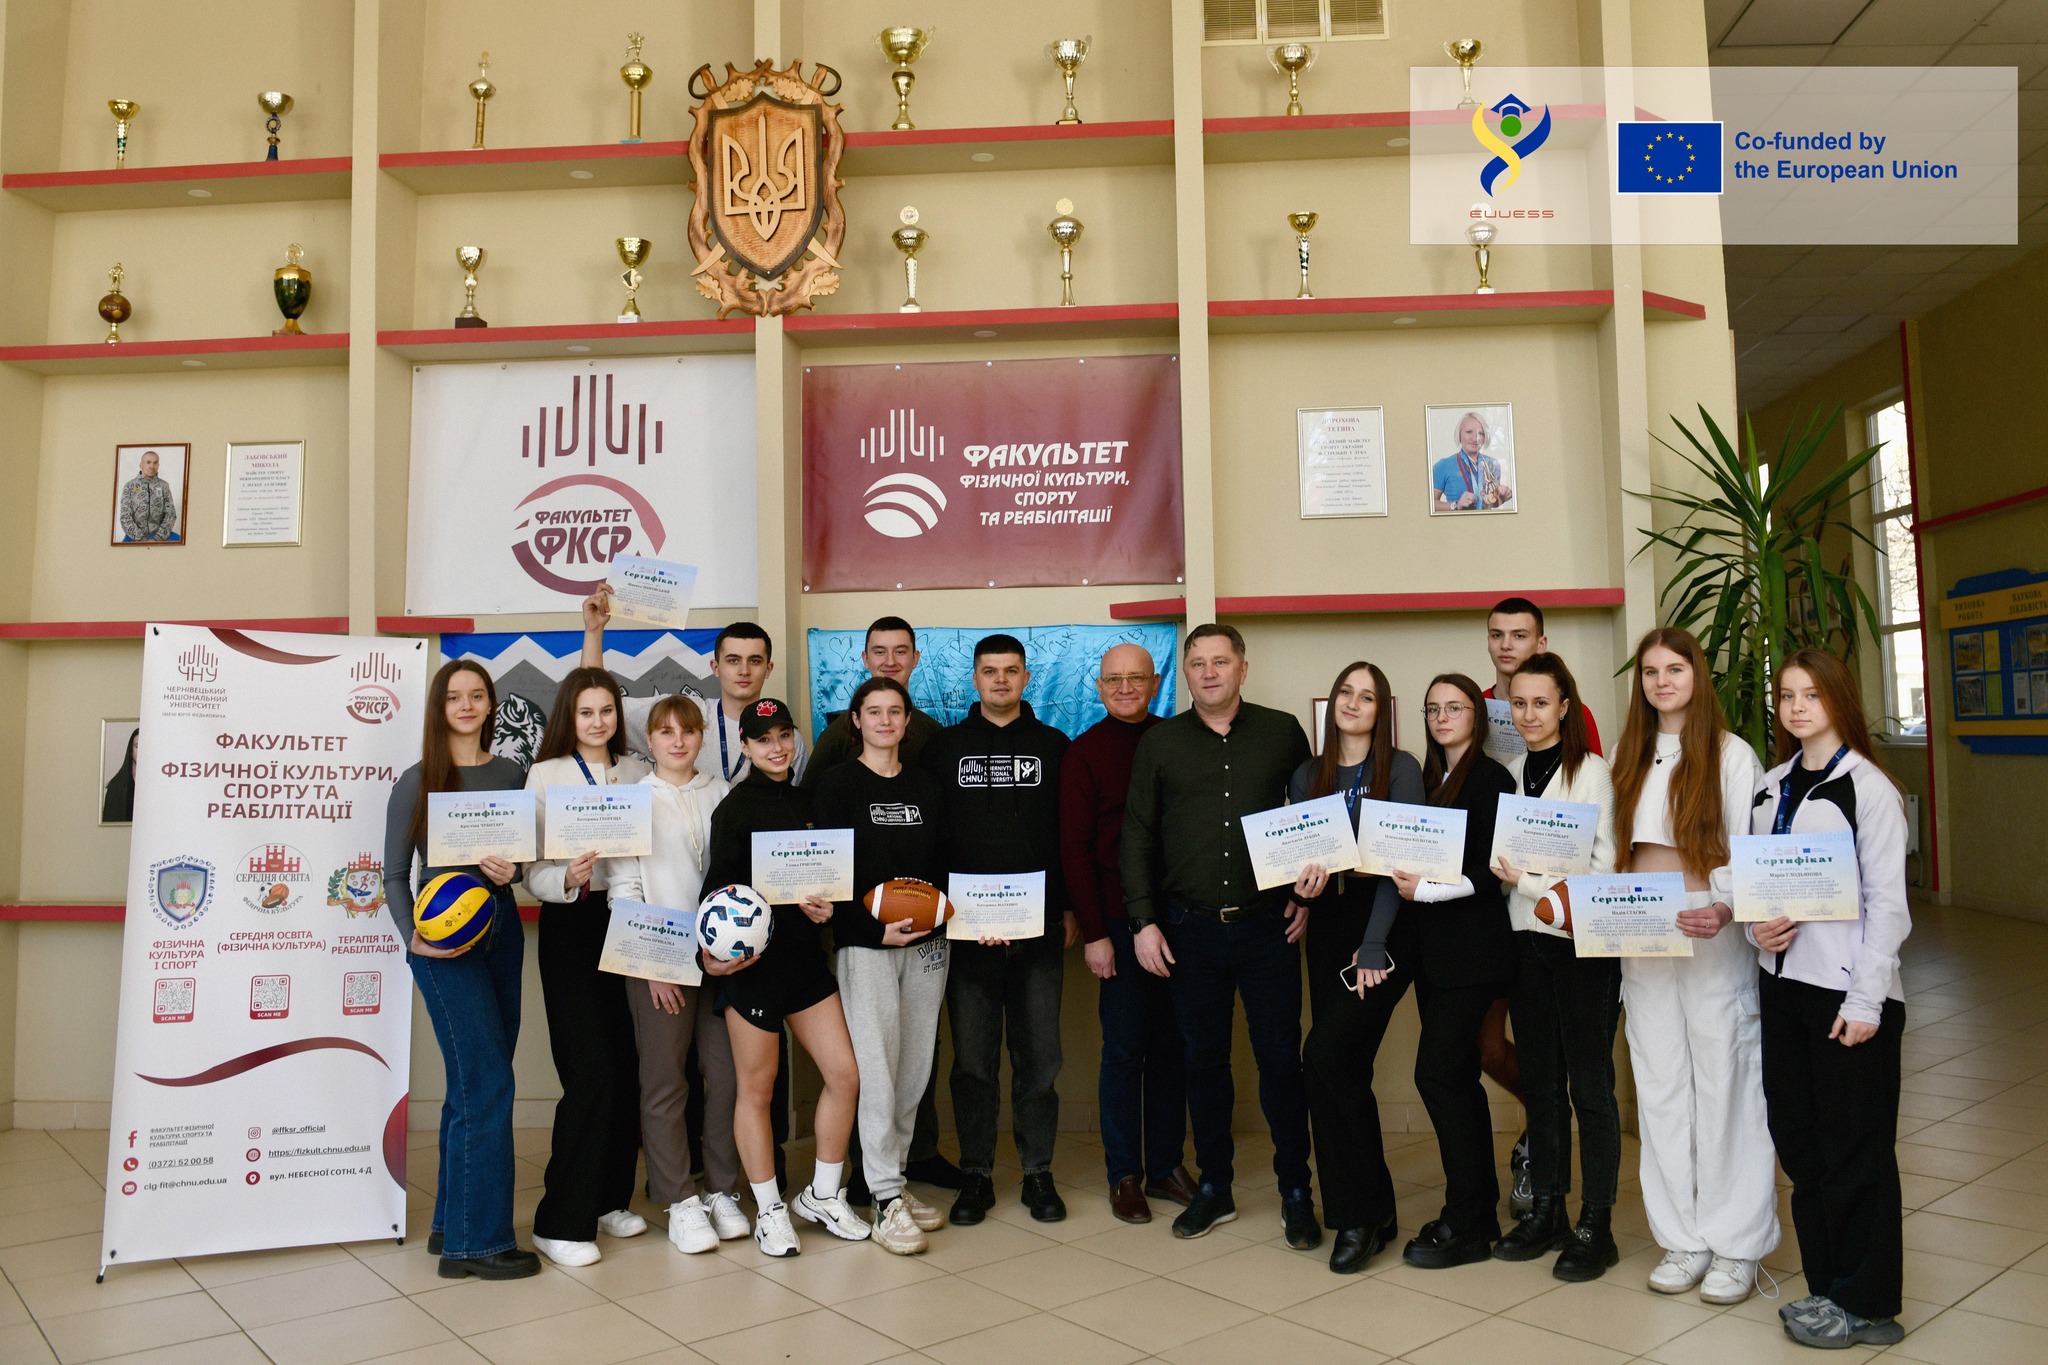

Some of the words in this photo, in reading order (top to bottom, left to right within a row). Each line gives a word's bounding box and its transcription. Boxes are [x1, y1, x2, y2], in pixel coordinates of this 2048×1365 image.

[963, 440, 1129, 469] ФАКУЛЬТЕТ
[959, 471, 1041, 489] ФІЗИЧНОЇ
[1044, 470, 1130, 487] КУЛЬТУРИ,
[1014, 491, 1077, 507] СПОРТУ
[534, 508, 632, 525] ФАКУЛЬТЕТ
[980, 511, 1000, 525] ТА
[1003, 505, 1113, 525] РЕАБІЛІТАЦІЇ
[534, 525, 632, 565] ФКСР
[624, 570, 678, 586] Сертифікат
[178, 666, 218, 682] ЧНУ
[166, 686, 226, 695] ЧЕРНІВЕЦЬКИЙ
[163, 693, 228, 703] НАЦІОНАЛЬНИЙ
[169, 701, 221, 710] УНІВЕРСИТЕТ
[354, 701, 389, 714] ФКСР
[215, 732, 348, 752] ФАКУЛЬТЕТ
[161, 762, 278, 780] ФІЗИЧНОЇ
[282, 765, 399, 784] КУЛЬТУРИ,
[960, 775, 983, 783] CHNU
[223, 783, 308, 800] СПОРТУ
[313, 784, 339, 800] ТА
[207, 802, 352, 823] РЕАБІЛІТАЦІЇ
[448, 809, 515, 819] Сертифікат
[565, 804, 632, 812] Сертифікат
[1265, 817, 1330, 837] Сертифікат
[1379, 820, 1446, 834] Сертифікат
[1516, 815, 1580, 829] Сертифікат
[771, 849, 835, 858] Сертифікат
[1755, 856, 1833, 866] Сертифікат
[236, 873, 277, 883] СЕРЕДНЯ
[278, 873, 310, 883] ОСВІТА
[966, 891, 1028, 899] Сертифікат
[1591, 894, 1664, 904] Сертифікат
[627, 920, 690, 938] Сертифікат
[229, 931, 274, 942] СЕРЕДНЯ
[277, 930, 313, 940] ОСВІТА
[338, 935, 381, 944] ТЕРАПІЯ
[382, 934, 394, 943] ТА
[152, 939, 205, 949] ФІЗИЧНА
[217, 942, 269, 954] (ФІЗИЧНА
[272, 940, 327, 952] КУЛЬТУРА)
[331, 944, 400, 955] РЕАБІЛІТАЦІЯ
[149, 949, 205, 960] КУЛЬТУРА
[161, 960, 198, 970] СПОРТ
[272, 1125, 326, 1135] @ffksr_official
[268, 1144, 371, 1158] https://fizkult.chnu.edu.ua
[148, 1159, 176, 1169] (0372)
[178, 1158, 189, 1167] 52
[190, 1157, 201, 1165] 00
[203, 1156, 214, 1164] 58
[288, 1167, 329, 1179] НЕБЕСНОЇ
